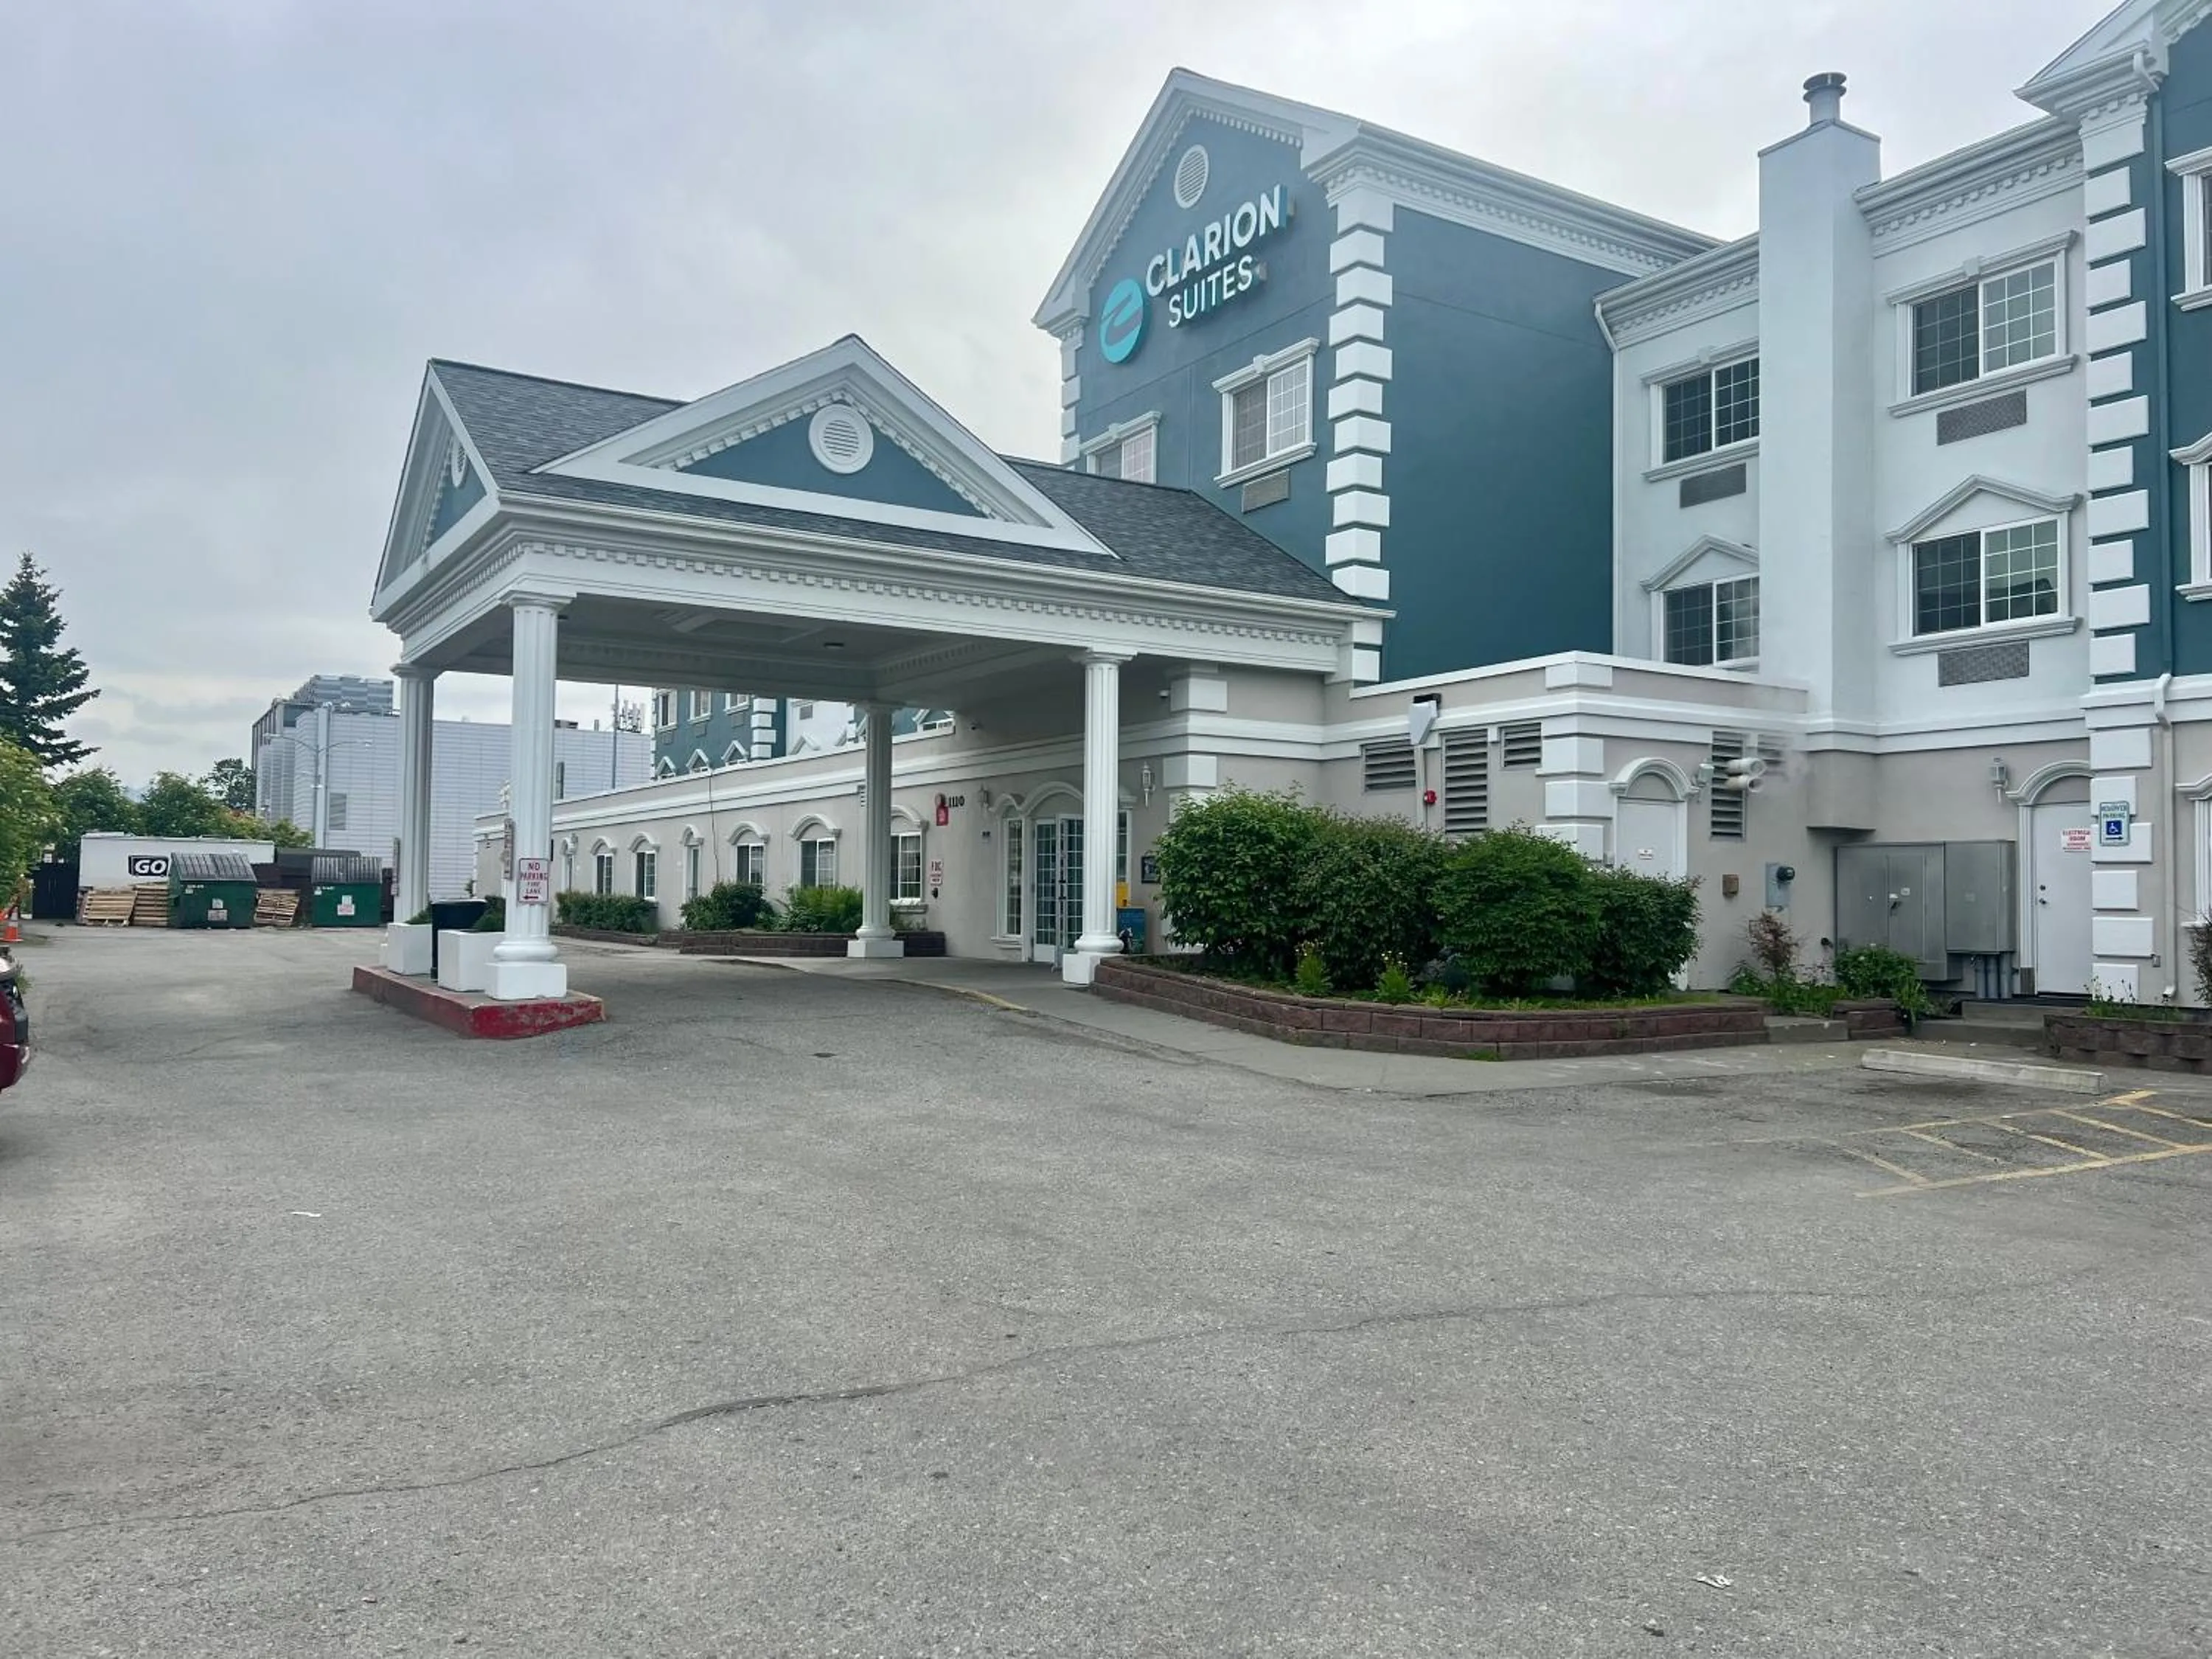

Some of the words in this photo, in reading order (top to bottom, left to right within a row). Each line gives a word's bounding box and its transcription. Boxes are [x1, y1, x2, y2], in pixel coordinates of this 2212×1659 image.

[1146, 184, 1283, 297] CLARION
[1169, 255, 1253, 327] SUITES
[135, 859, 167, 874] GO
[527, 862, 540, 871] NO
[519, 872, 549, 881] PARKING
